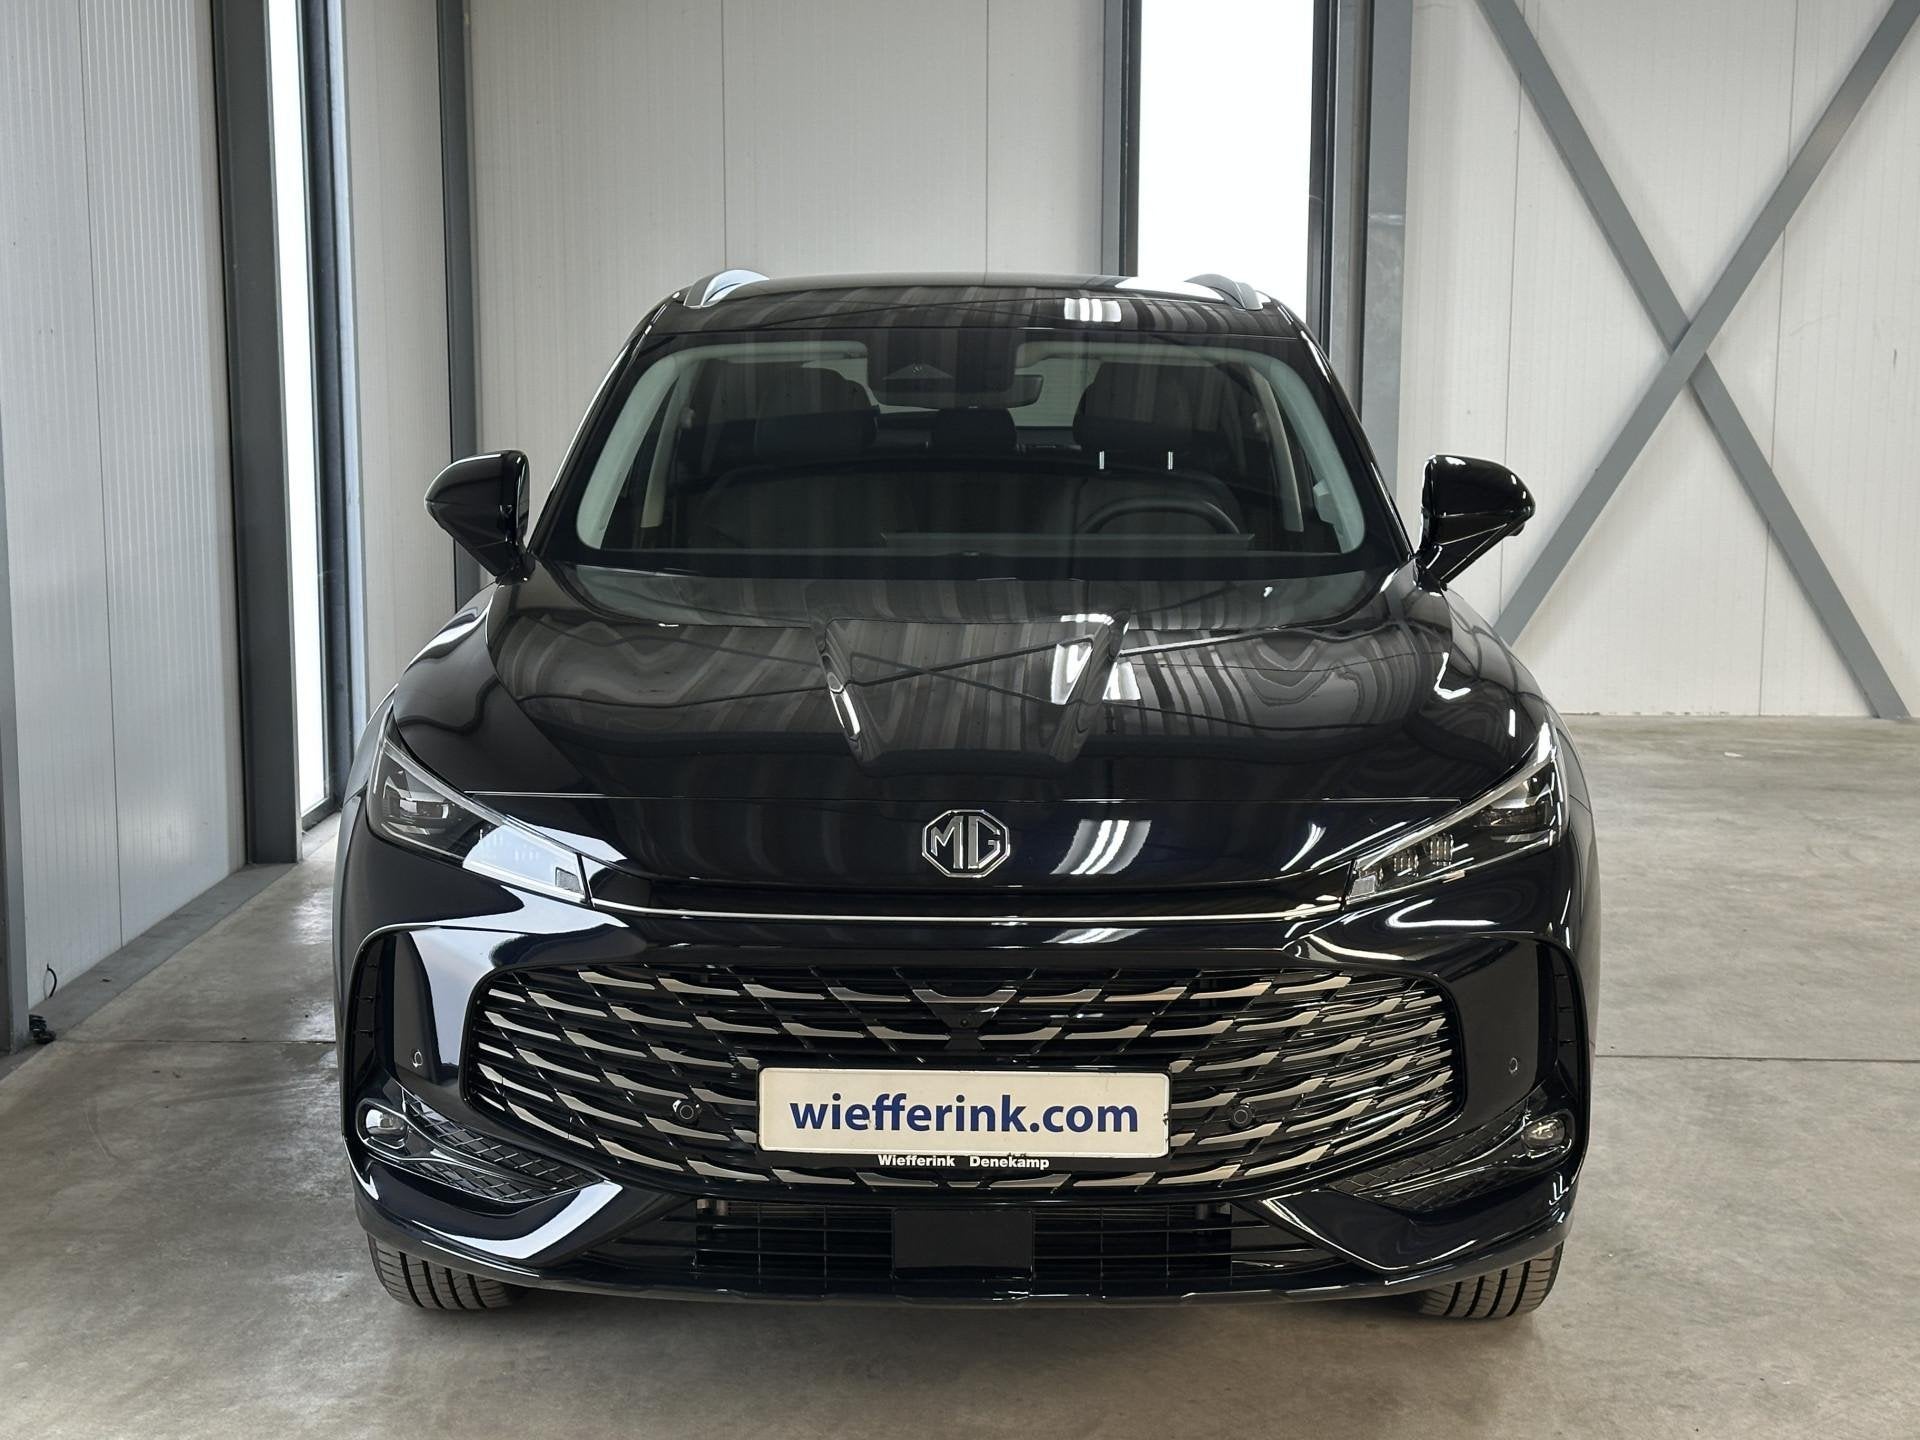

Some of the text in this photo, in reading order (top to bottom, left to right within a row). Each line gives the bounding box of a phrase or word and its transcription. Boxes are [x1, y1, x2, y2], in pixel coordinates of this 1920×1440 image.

[930, 815, 1001, 869] MG
[789, 1093, 1138, 1133] wiefferink.com
[877, 1154, 1050, 1170] Wiefferink Denekamp
